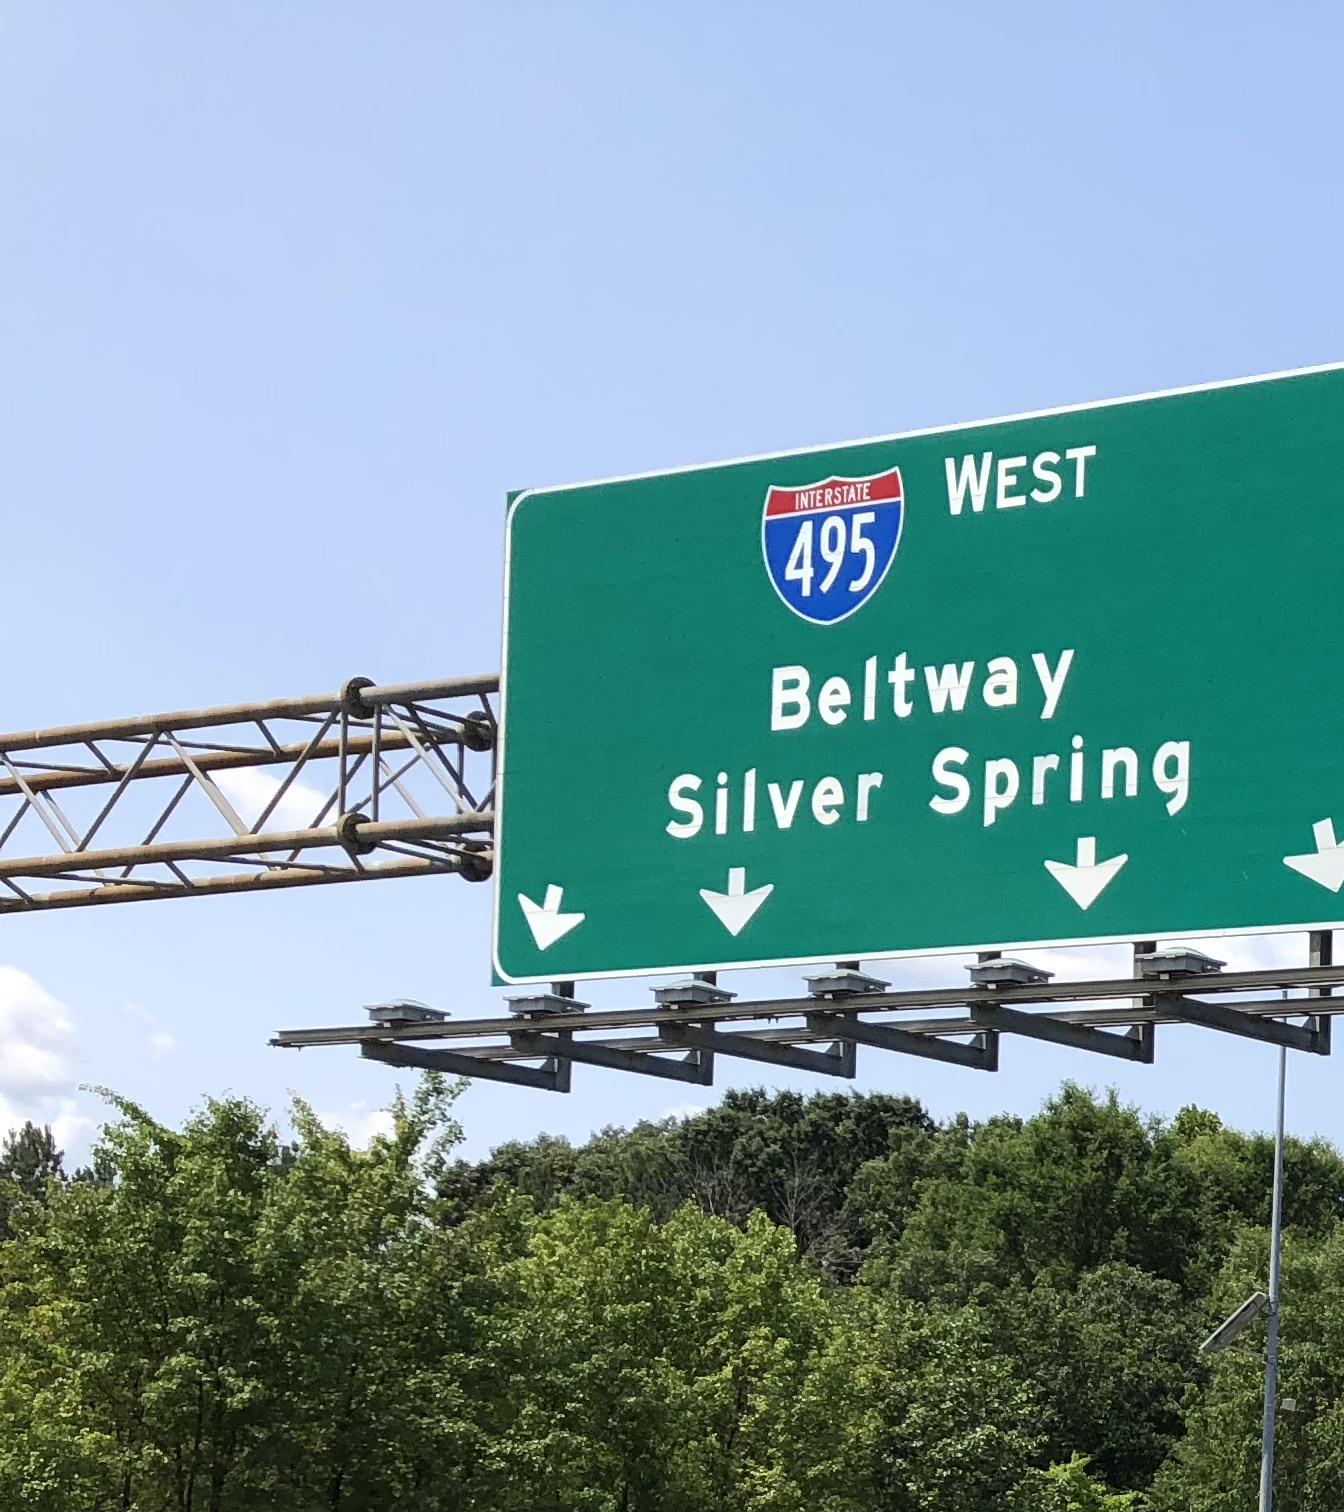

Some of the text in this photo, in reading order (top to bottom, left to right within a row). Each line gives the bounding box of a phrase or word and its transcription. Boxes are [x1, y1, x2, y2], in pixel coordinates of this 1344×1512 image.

[795, 482, 872, 510] INTERSTATE
[944, 445, 1097, 516] WEST
[785, 511, 875, 597] 495
[771, 649, 1075, 731] Beltway
[665, 735, 1190, 839] Silver Spring
